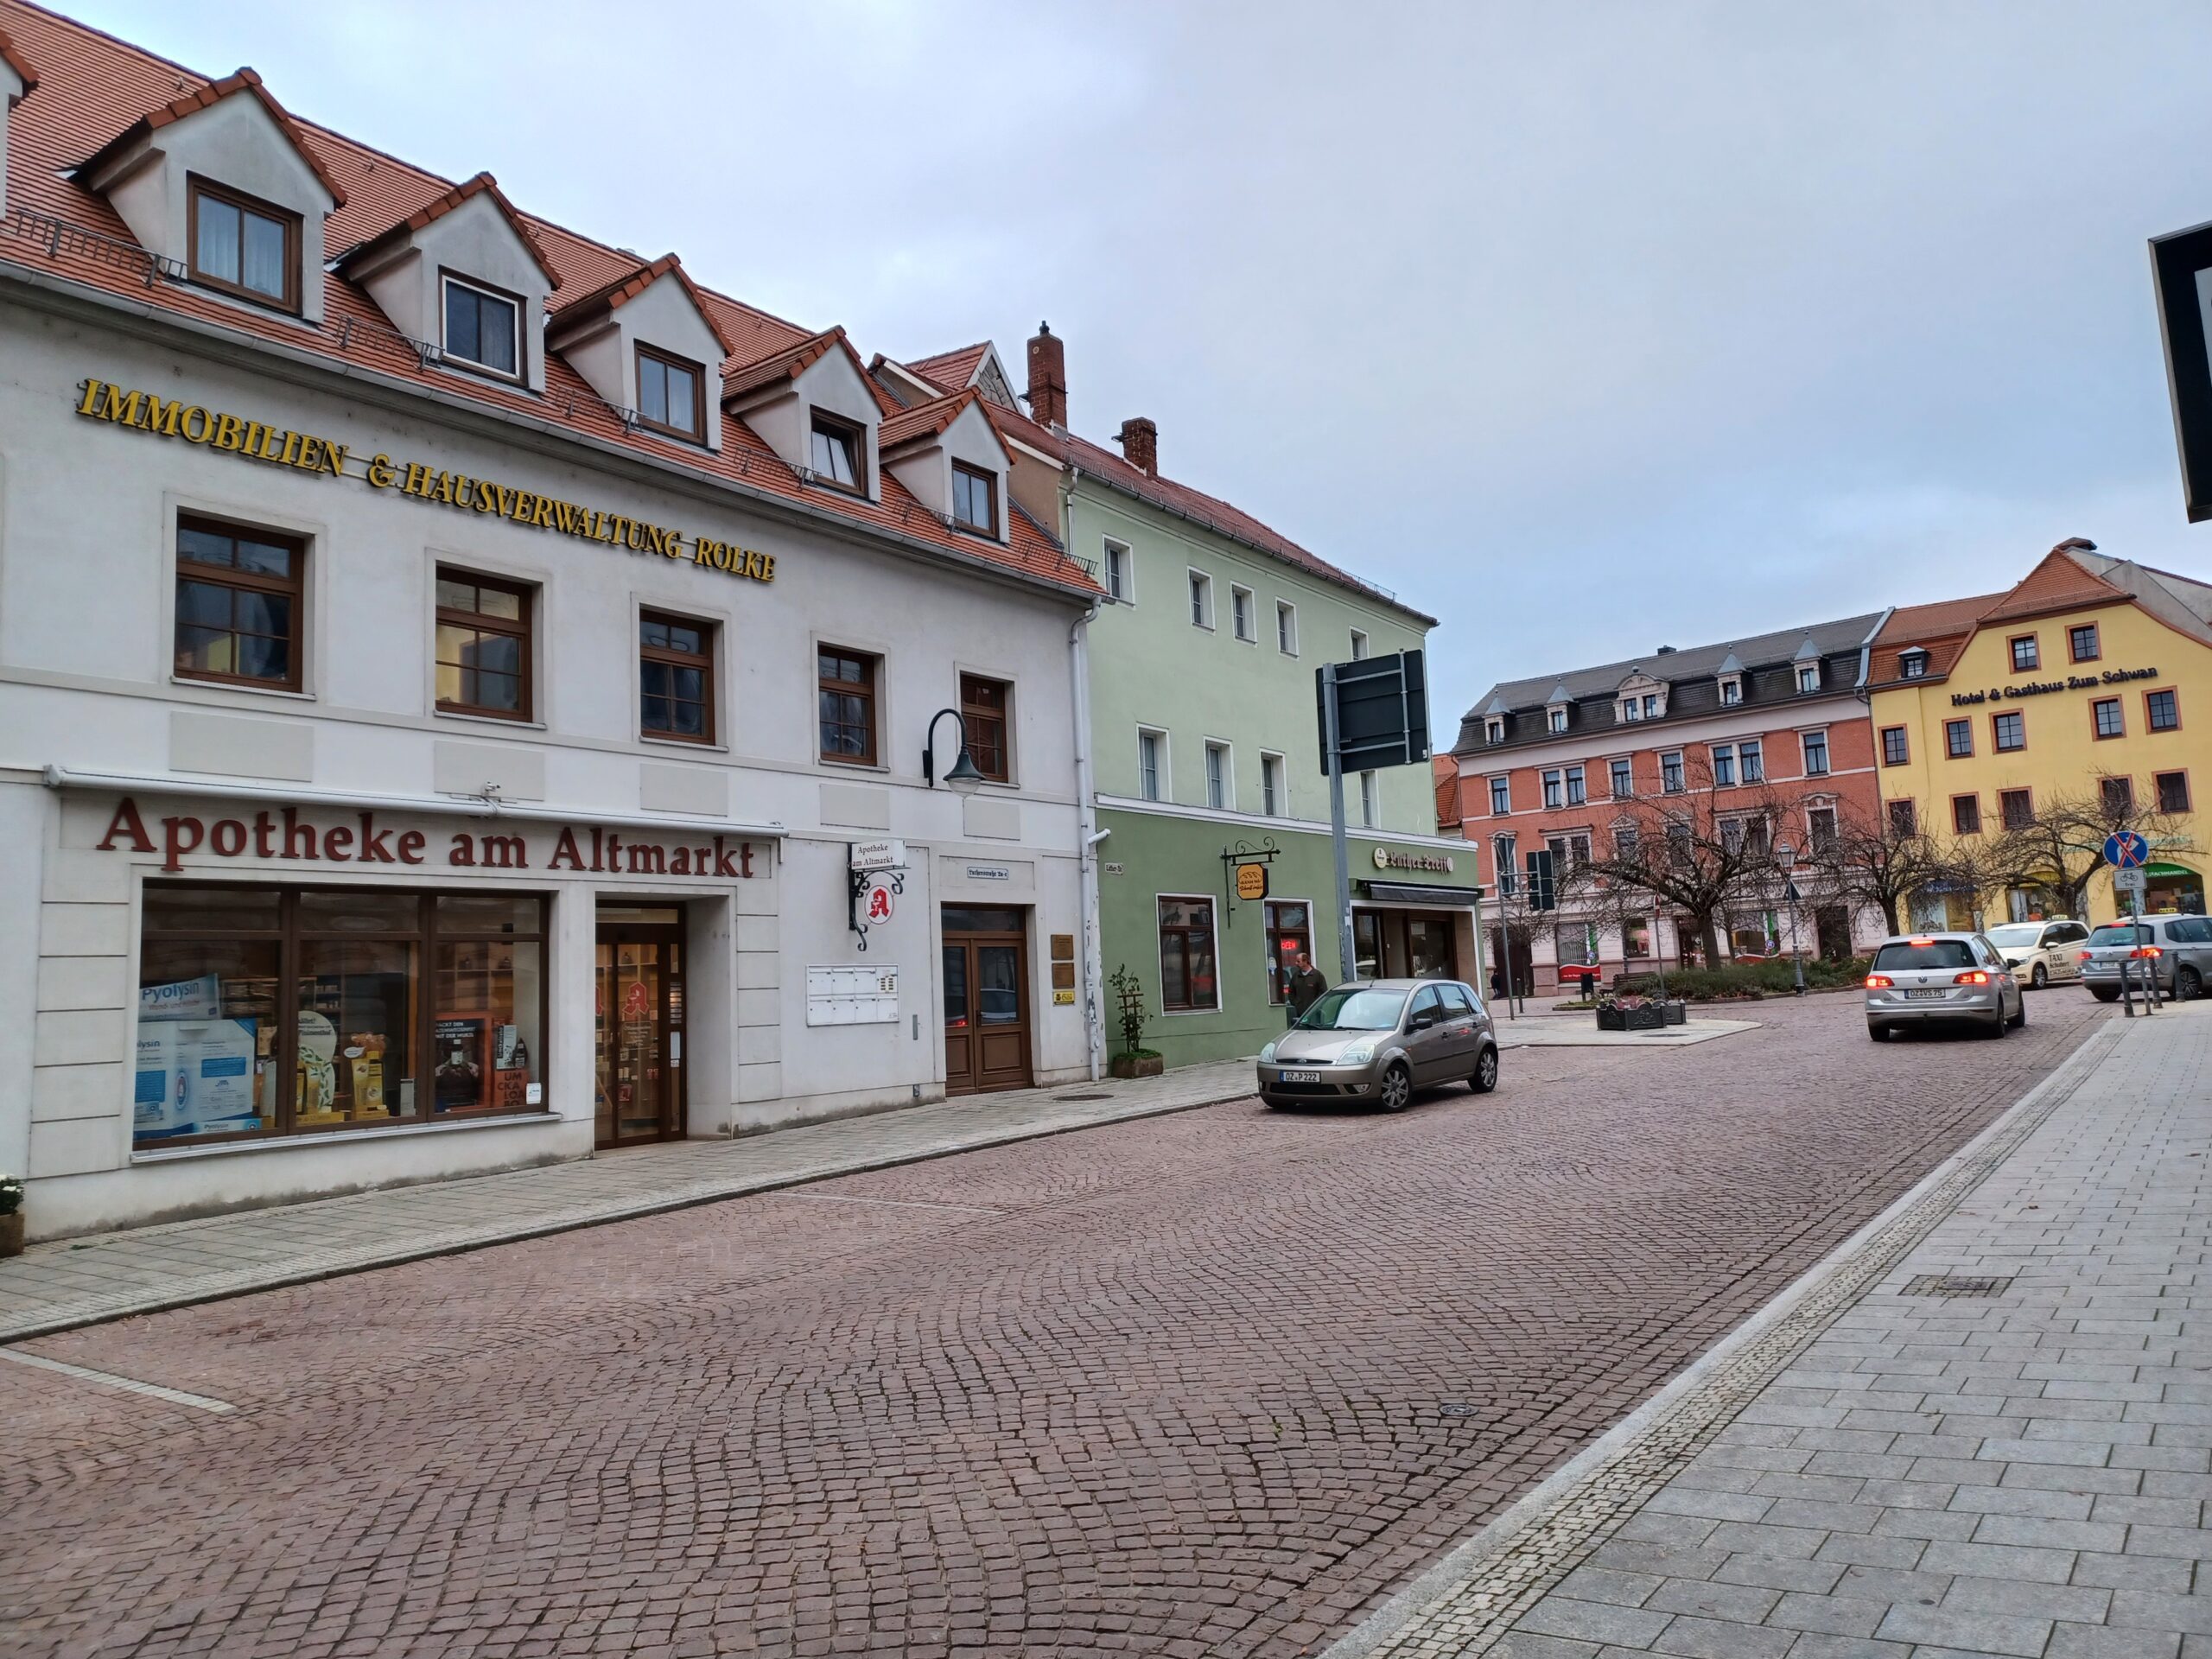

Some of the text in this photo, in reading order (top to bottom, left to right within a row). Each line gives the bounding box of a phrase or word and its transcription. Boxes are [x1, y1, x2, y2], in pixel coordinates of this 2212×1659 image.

[76, 378, 776, 583] IMMOBILIEN & HAUSVERWALTUNG ROLKE
[1951, 666, 2158, 707] Hotel & Gasthaus Zum Schwan
[96, 797, 754, 878] Apotheke am Altmarkt
[857, 843, 888, 854] Apotheke
[864, 856, 893, 866] Altmarkt
[2049, 953, 2063, 962] TAXI
[142, 982, 200, 1003] Pyolysin
[505, 1072, 522, 1081] UM
